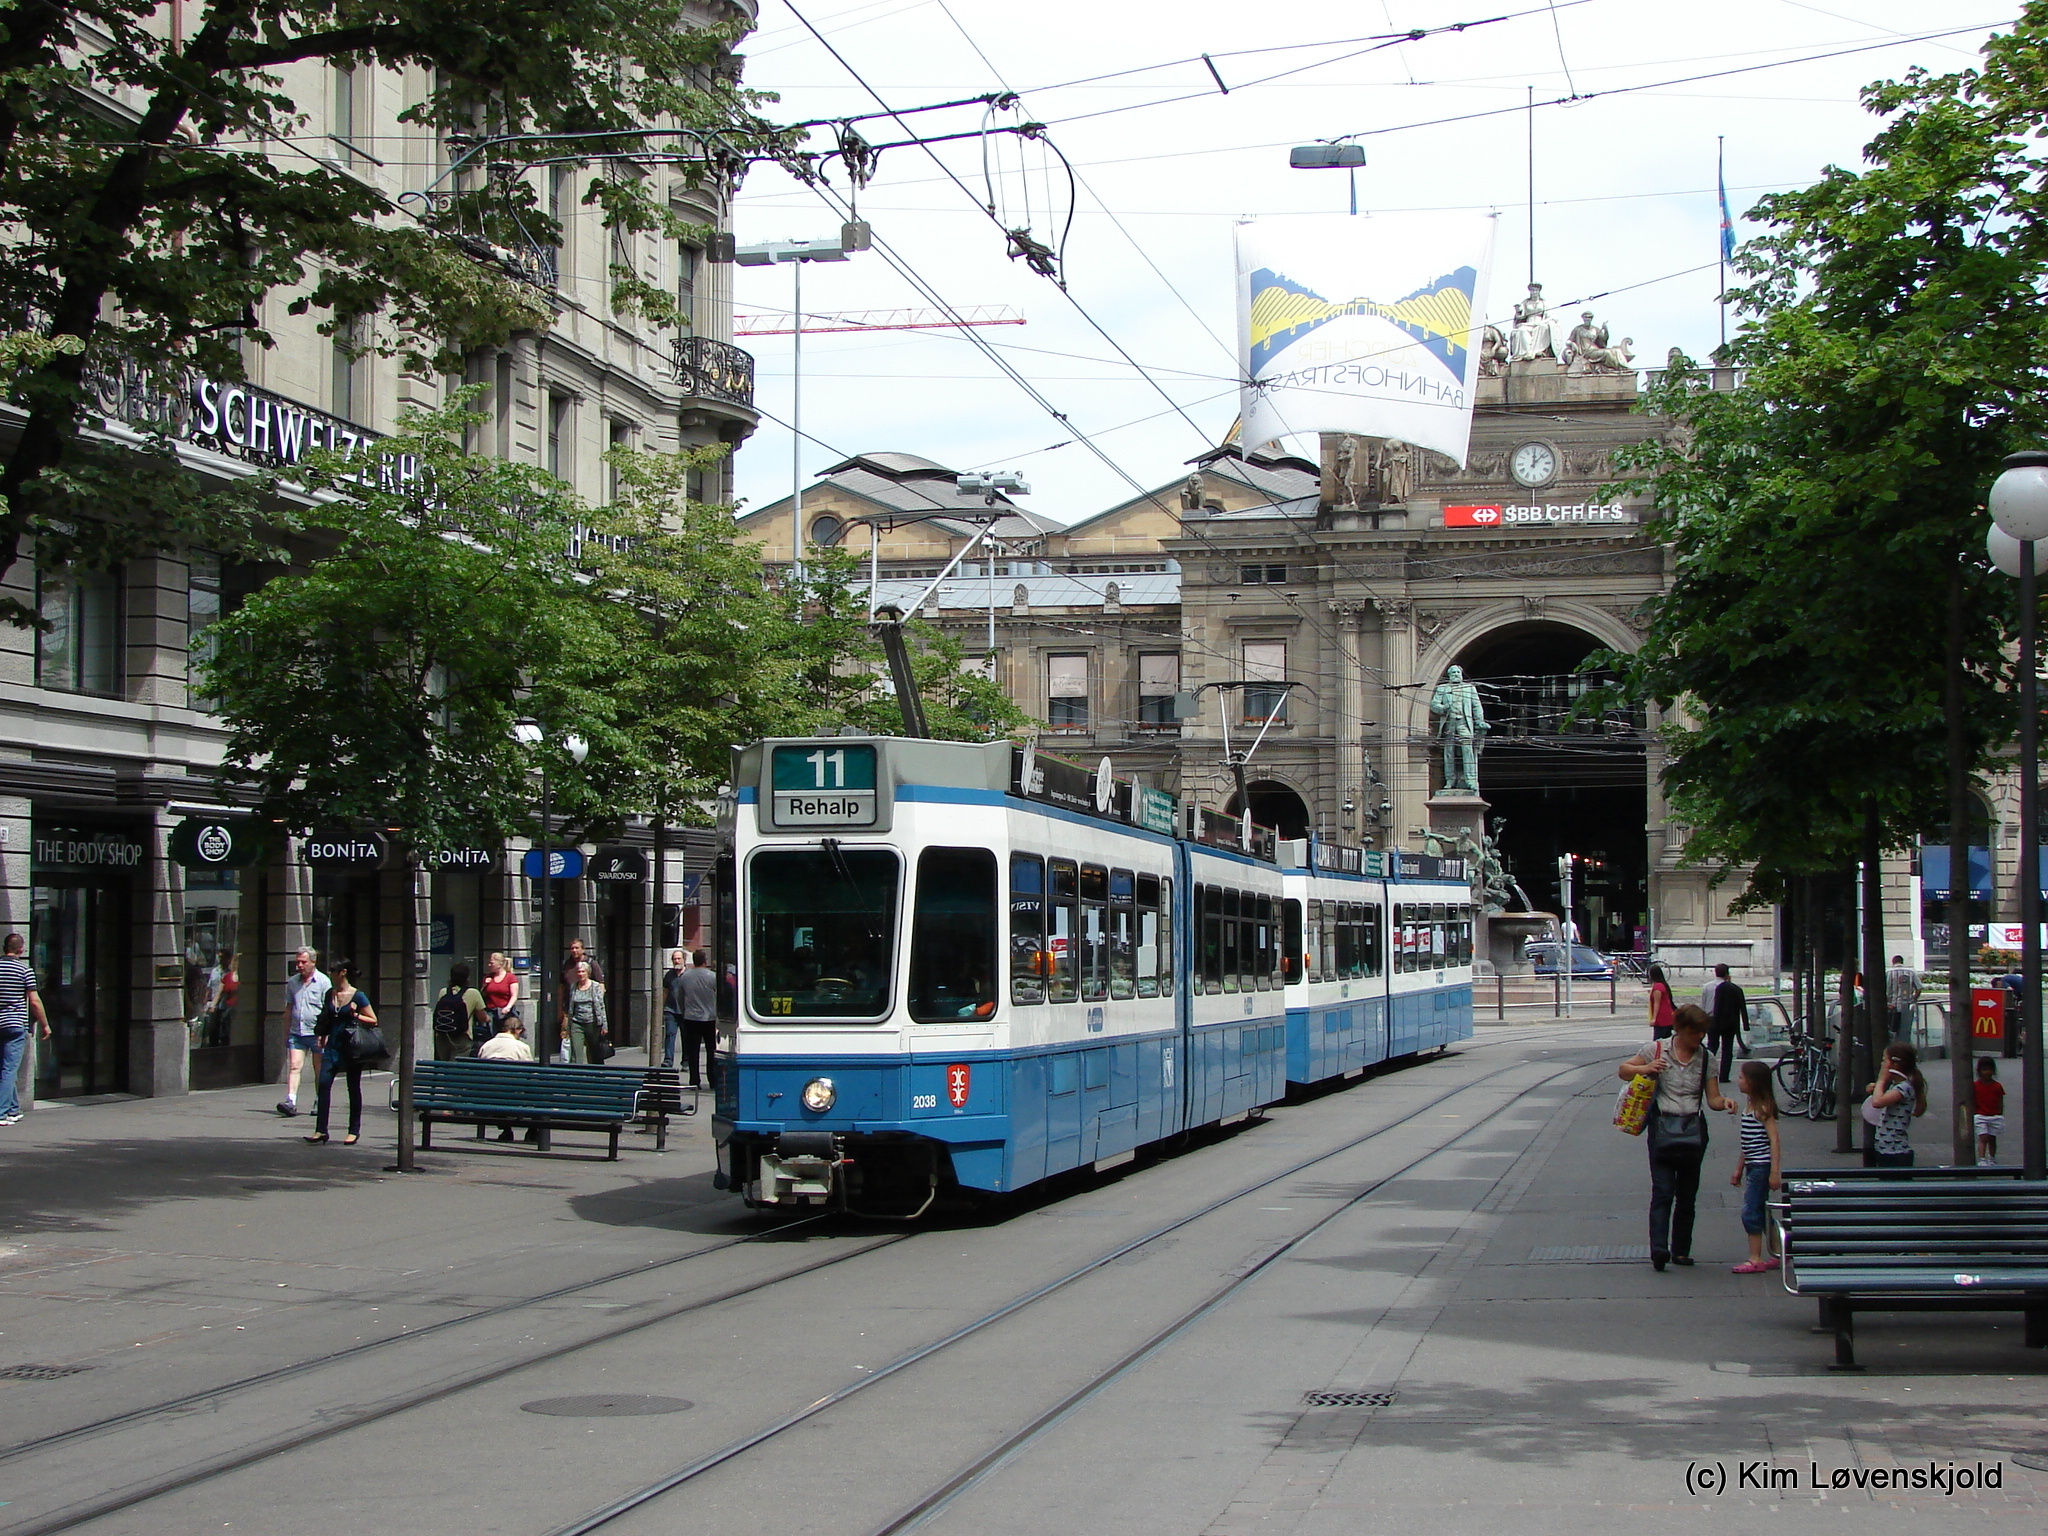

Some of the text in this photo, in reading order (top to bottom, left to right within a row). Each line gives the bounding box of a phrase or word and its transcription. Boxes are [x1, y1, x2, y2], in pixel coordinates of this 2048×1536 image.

[1505, 504, 1623, 522] SBB CFF FFS
[806, 749, 844, 788] 11
[790, 798, 859, 818] Rehalp
[36, 839, 143, 866] THE BODY SHOP
[598, 872, 637, 880] SWAROVSKI
[772, 1000, 790, 1011] 07
[913, 1094, 936, 1109] 2038
